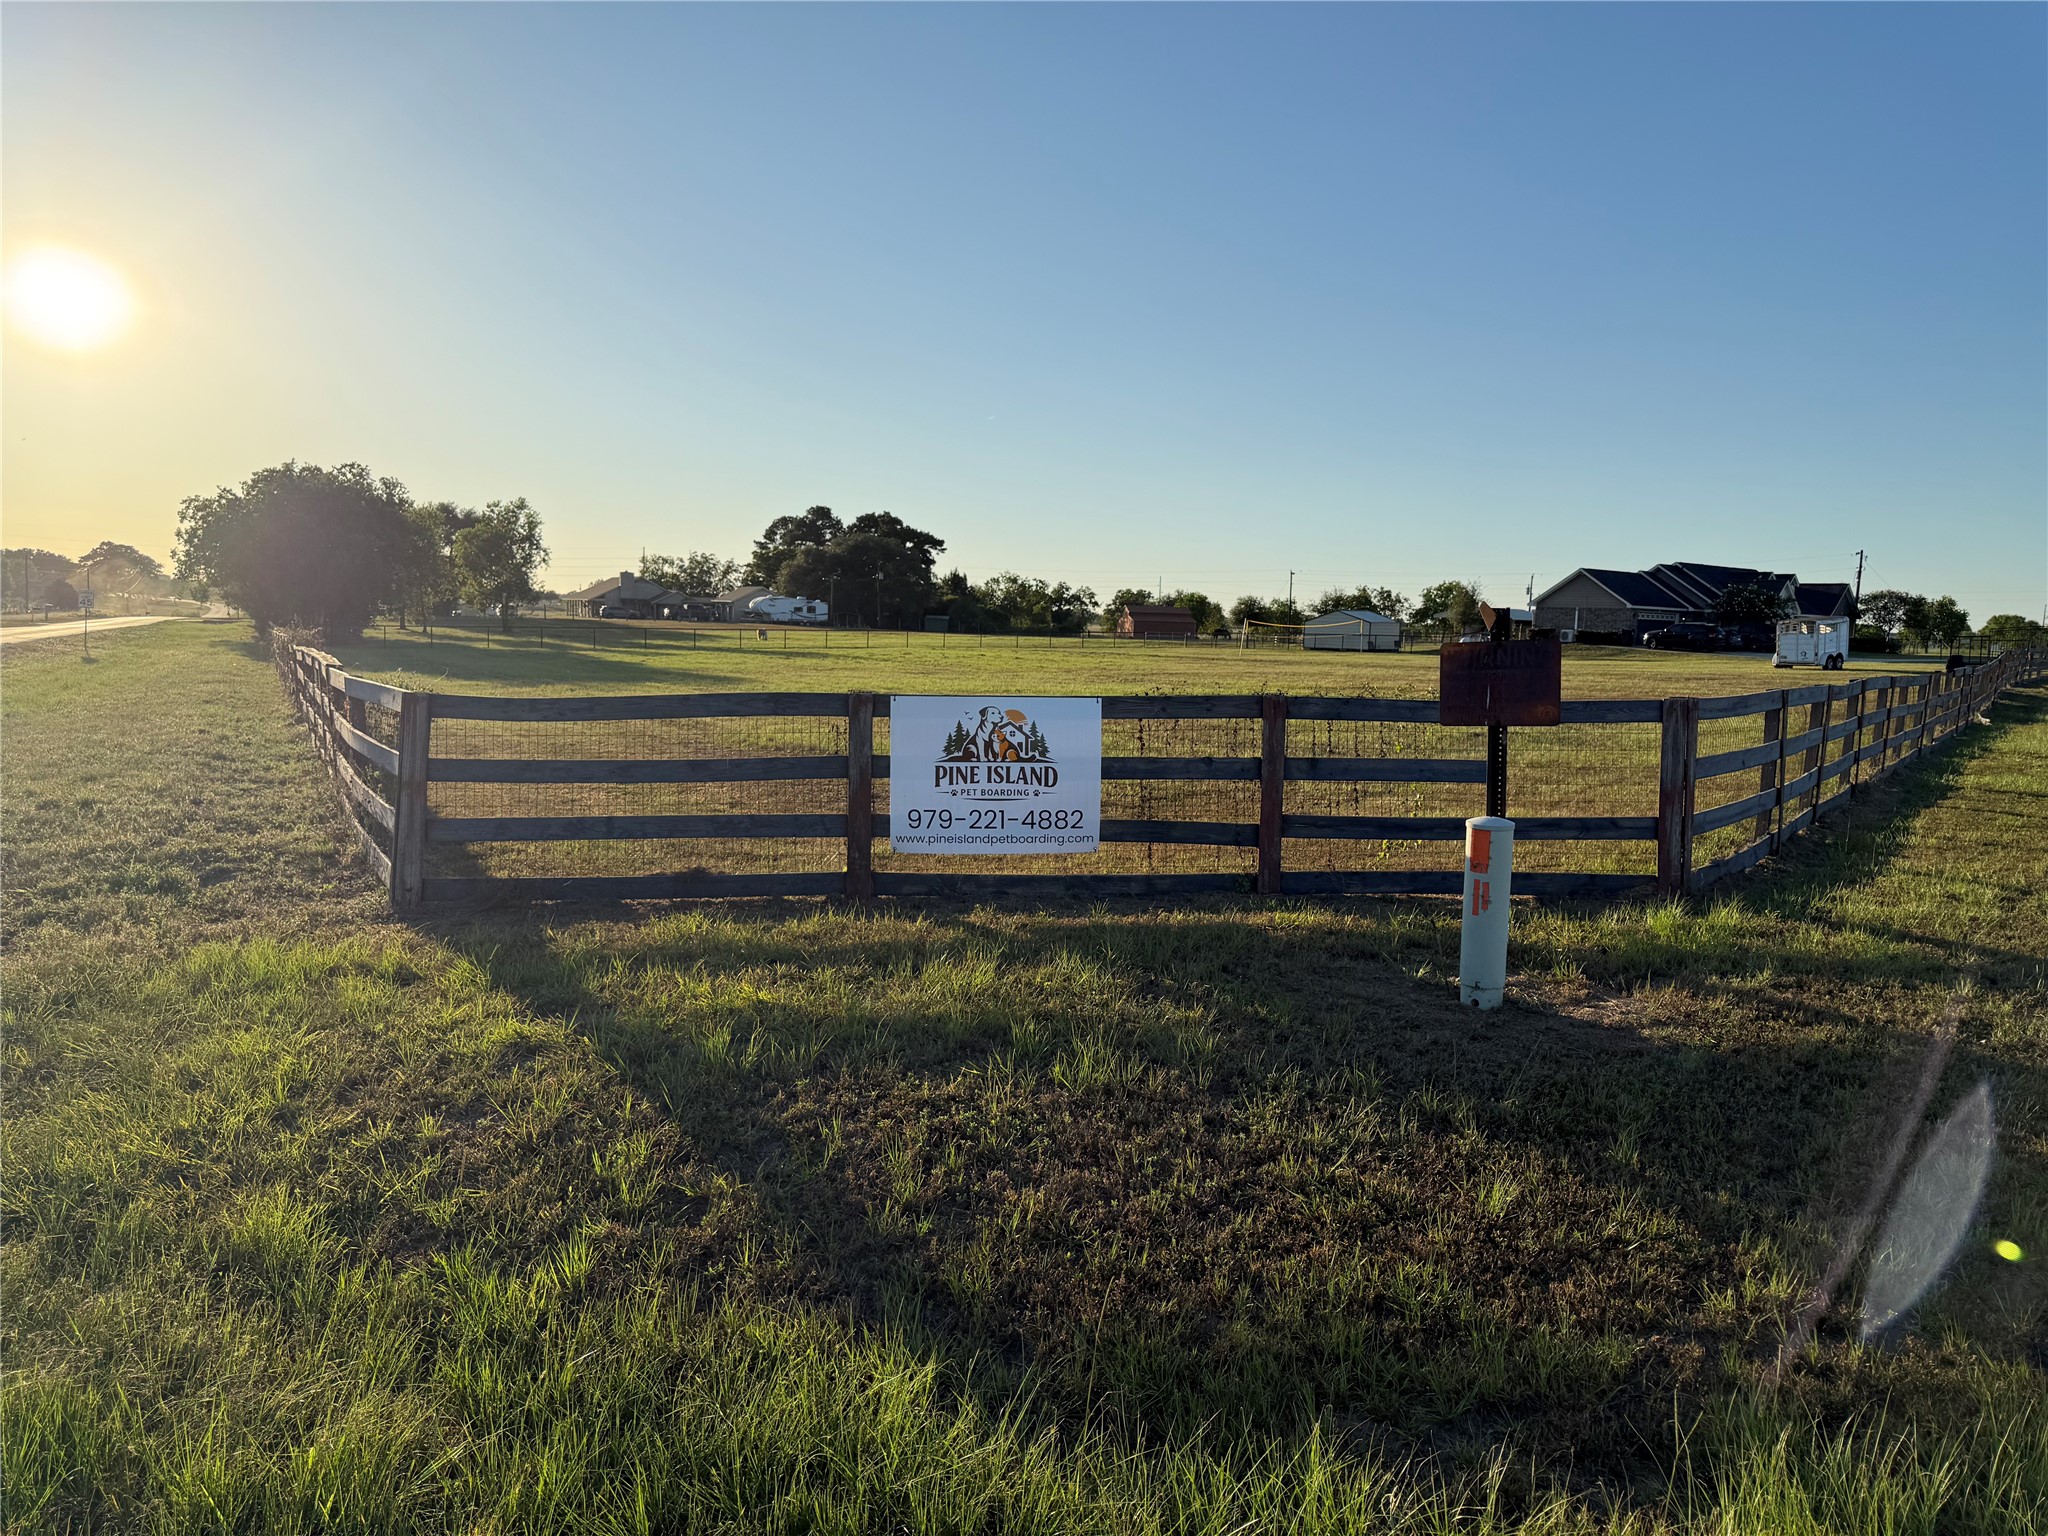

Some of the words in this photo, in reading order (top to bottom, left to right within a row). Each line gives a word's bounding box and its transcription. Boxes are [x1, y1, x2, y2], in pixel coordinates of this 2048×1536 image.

[934, 765, 980, 788] PINE
[987, 765, 1059, 788] ISLAND
[960, 788, 978, 797] PET
[980, 788, 1030, 797] BOARDING
[907, 808, 1084, 830] 979-221-4882
[895, 833, 1094, 847] www.pineislandpetboarding.com
